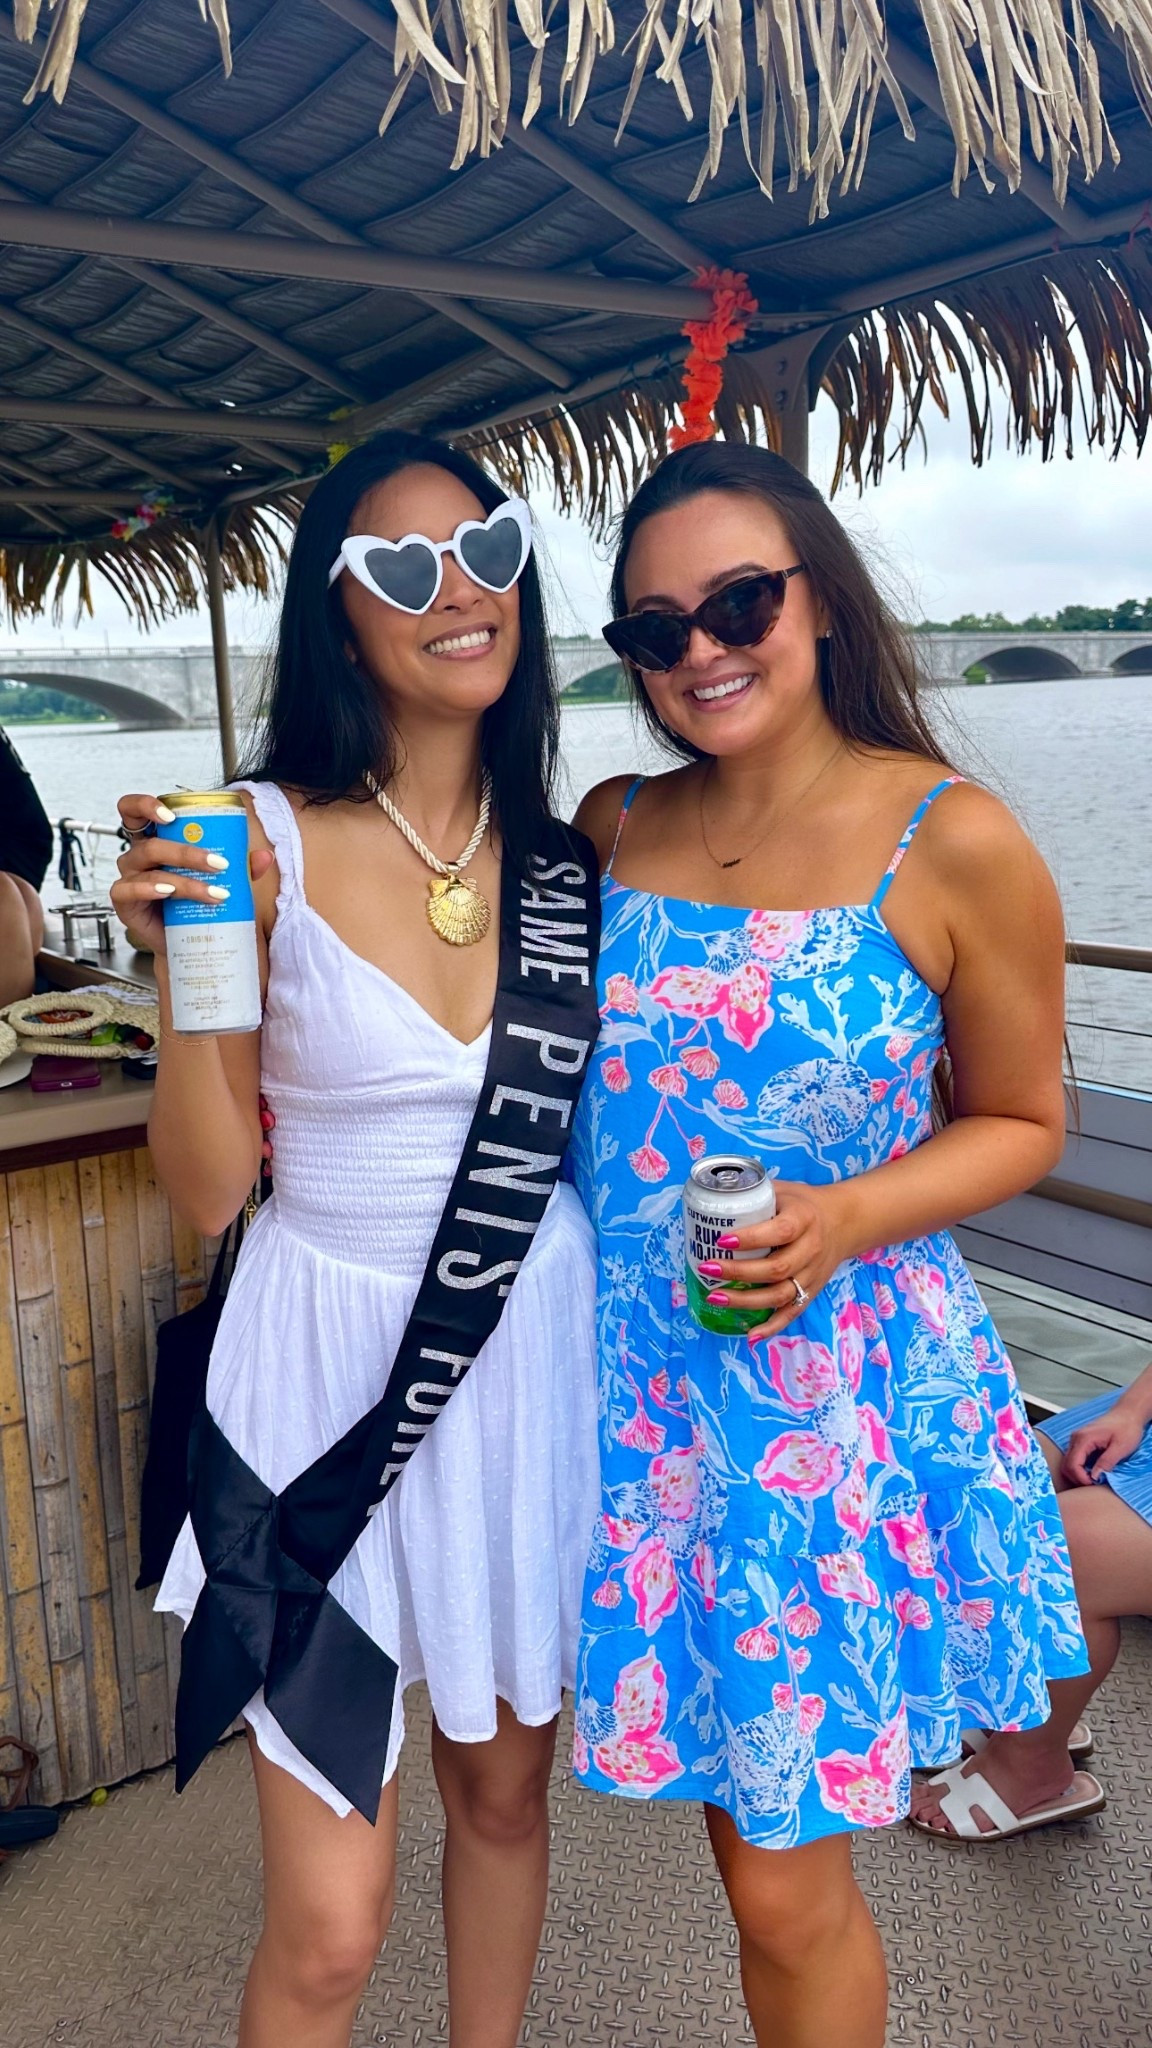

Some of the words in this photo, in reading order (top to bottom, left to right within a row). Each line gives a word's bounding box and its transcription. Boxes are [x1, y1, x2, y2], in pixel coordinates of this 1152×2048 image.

[520, 853, 590, 986] SAME
[436, 1023, 590, 1297] PENIS
[687, 1207, 733, 1227] CUTWATER
[695, 1224, 722, 1247] RUM
